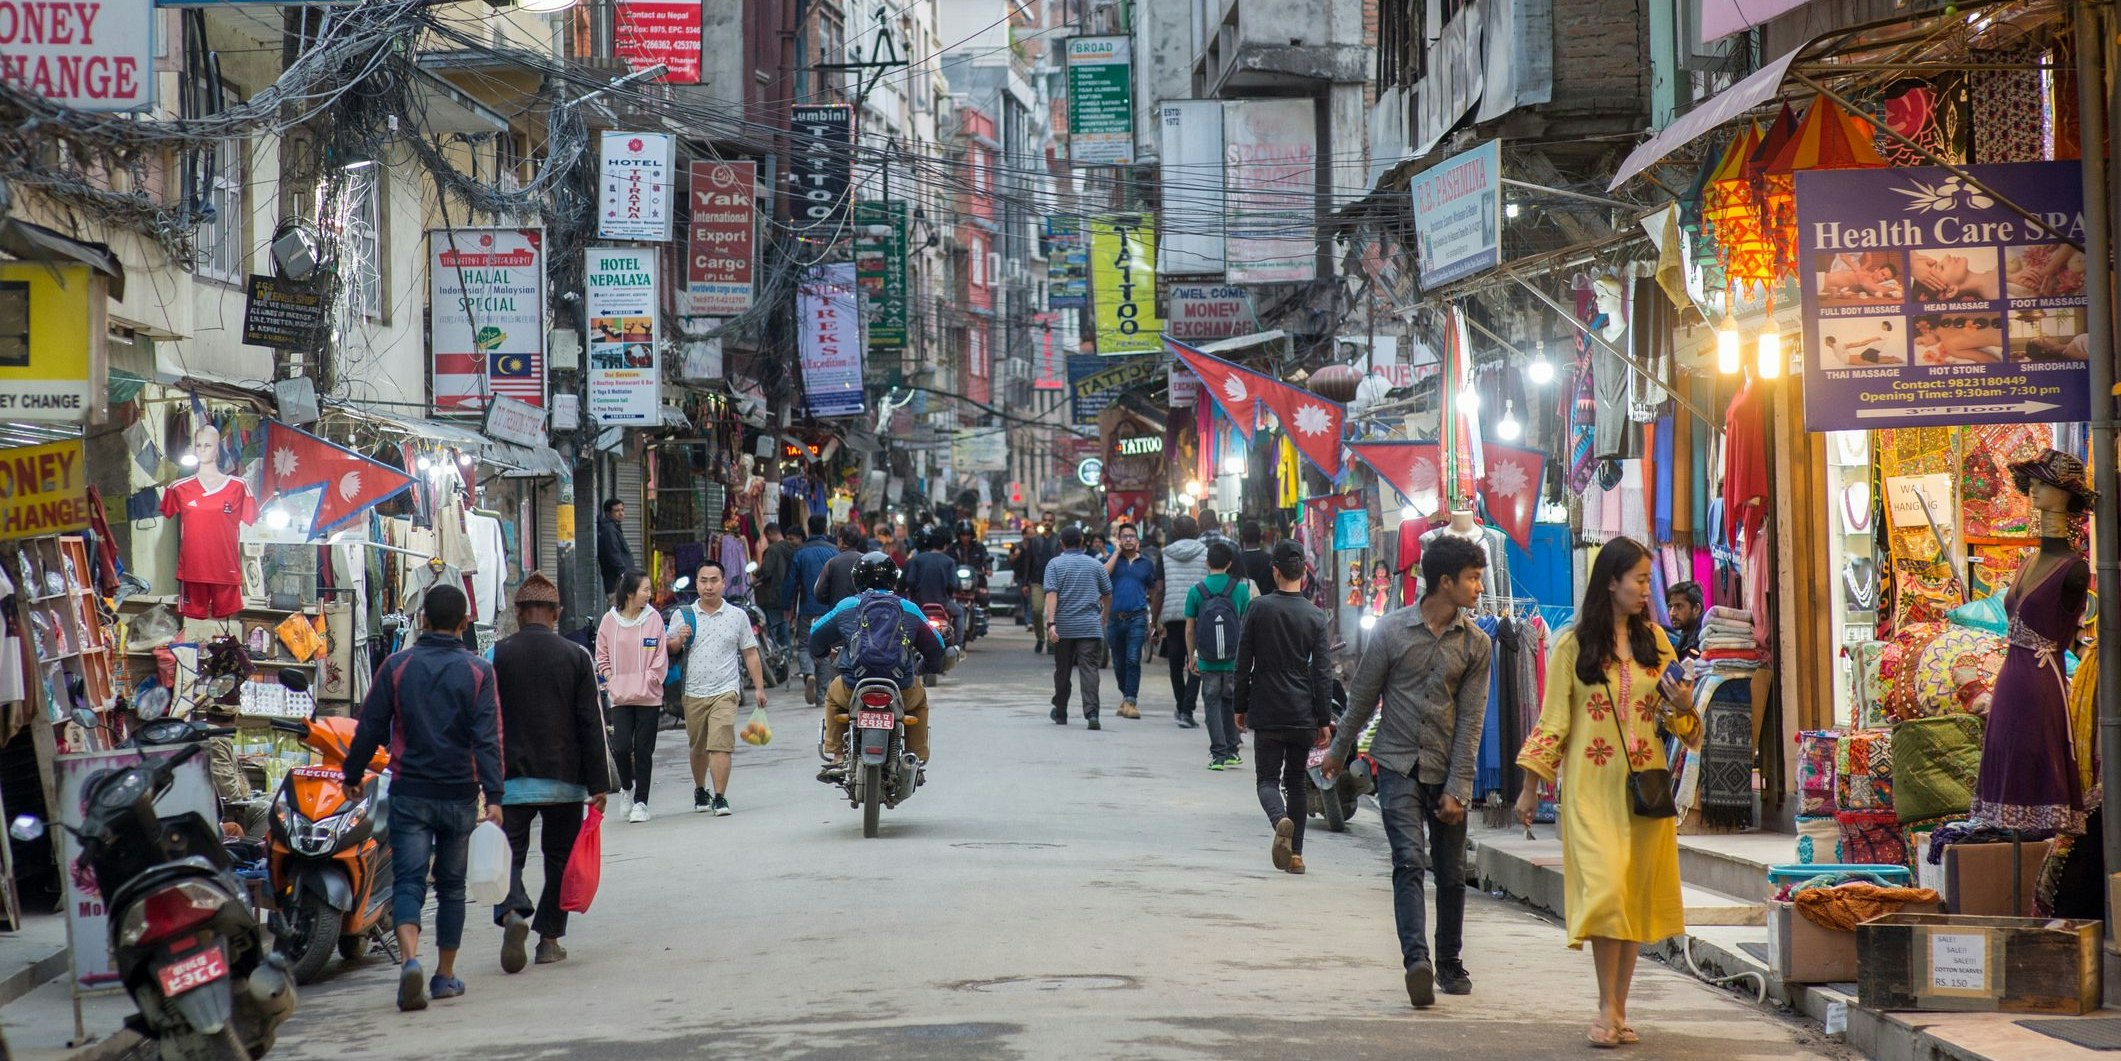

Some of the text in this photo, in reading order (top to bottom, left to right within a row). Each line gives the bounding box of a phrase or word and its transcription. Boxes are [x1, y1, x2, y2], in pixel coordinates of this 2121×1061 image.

[1076, 42, 1113, 53] BROAD
[791, 109, 847, 121] Lumbini
[806, 126, 832, 218] TATTOO
[1435, 157, 1487, 207] PASHMINA
[627, 169, 641, 219] TRIRATNA
[696, 191, 749, 206] Yak
[693, 210, 748, 223] International
[696, 228, 747, 244] Export
[1813, 211, 2086, 250] Health Care SPA
[600, 258, 640, 271] HOTEL
[695, 255, 746, 272] Cargo
[464, 269, 511, 284] HALAL
[590, 273, 652, 287] NEPALAYA
[704, 273, 717, 281] (P)
[1114, 226, 1139, 335] TATTOO
[494, 286, 536, 296] Malaysian
[1180, 288, 1247, 299] WEL COME
[459, 297, 517, 312] SPECIAL
[1184, 302, 1240, 317] MONEY
[1924, 302, 1990, 311] HEAD MASSAGE
[2011, 297, 2088, 308] FOOT MASSAGE
[1841, 307, 1862, 315] BODY
[1863, 305, 1901, 314] MASSAGE
[815, 296, 840, 356] TREKS
[1173, 321, 1252, 336] EXCHANGE
[1929, 365, 1987, 376] HOT STONE
[2020, 361, 2087, 372] SHIRODHARA
[1080, 363, 1152, 395] TATTOO
[1826, 368, 1900, 380] THAI MASSAGE
[1892, 376, 2027, 390] Contact: 9823180449
[21, 394, 80, 408] CHANGE
[1860, 390, 1915, 403] Opening
[1917, 388, 1953, 399] Time:
[2010, 386, 2037, 395] 7:30
[2040, 385, 2060, 397] pm
[1905, 405, 2017, 415] 3rd Floor
[1119, 436, 1162, 455] TATTOO
[1951, 979, 1968, 987] 150
